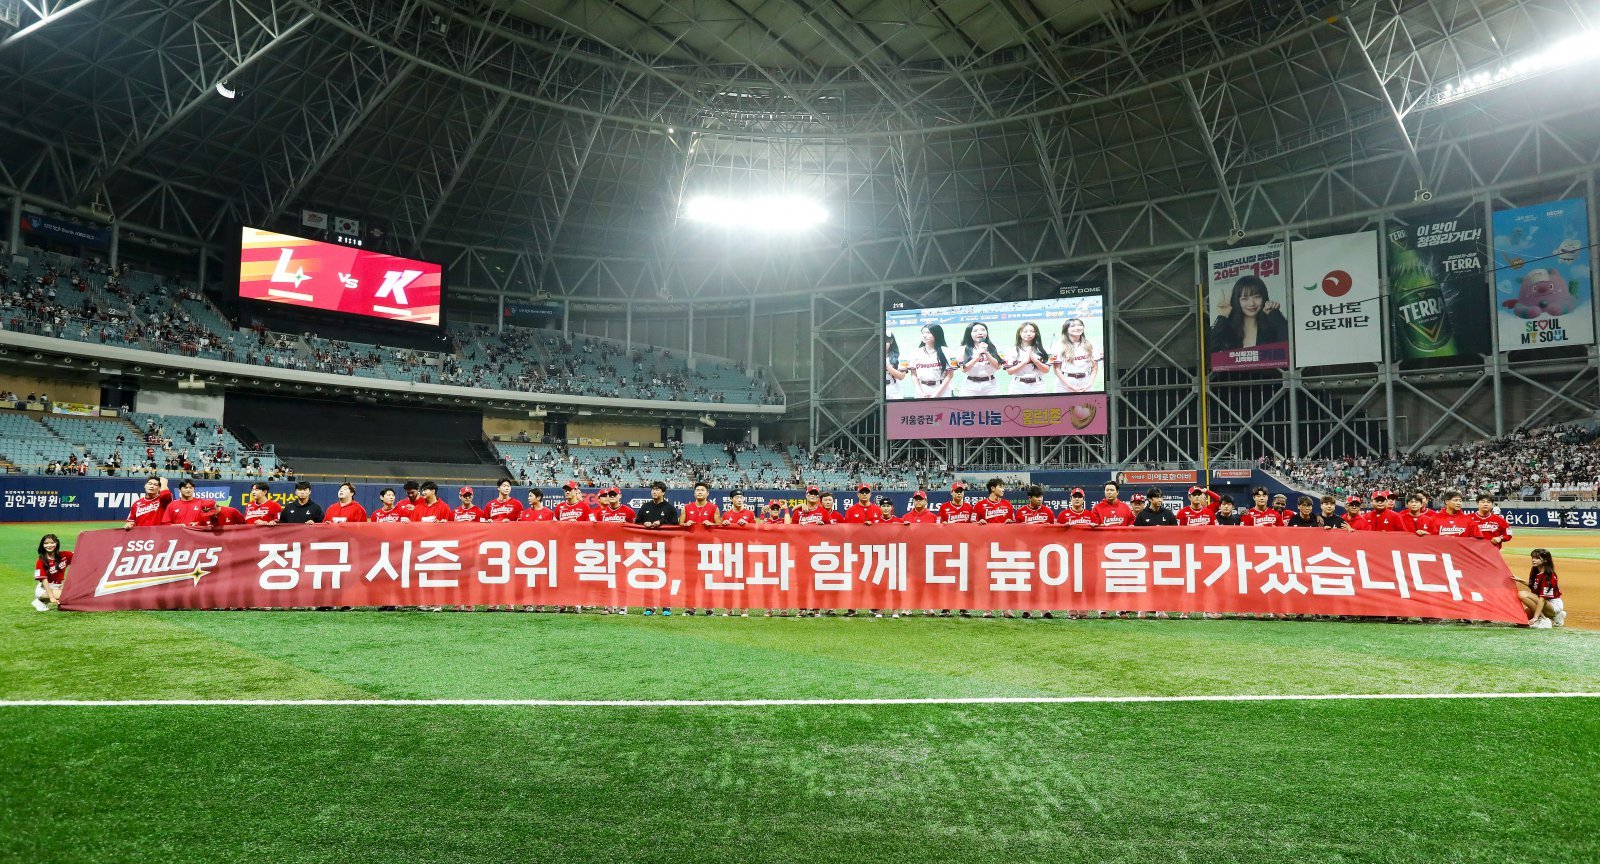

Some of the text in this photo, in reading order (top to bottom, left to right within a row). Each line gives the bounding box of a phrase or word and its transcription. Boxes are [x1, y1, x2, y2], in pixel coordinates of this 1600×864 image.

[1417, 220, 1458, 236] 이 맛이
[1417, 228, 1482, 248] 청정라거다!
[1213, 267, 1240, 281] 20년
[1250, 258, 1280, 278] 1위
[1442, 257, 1481, 272] TERRA
[1312, 301, 1362, 317] 하나로
[1399, 297, 1445, 324] TERRA
[1305, 316, 1370, 331] 의료재단
[901, 414, 934, 425] 키움증권
[949, 411, 976, 426] 사랑
[978, 411, 1002, 426] 나눔
[5, 495, 58, 508] 김안과병원
[985, 505, 1009, 519] Landers
[126, 540, 155, 551] SSG
[94, 540, 223, 597] Landers
[257, 538, 1484, 602] 정규 시즌 3위 확정, 팬과 함께 더 높이 올라가겠습니다.
